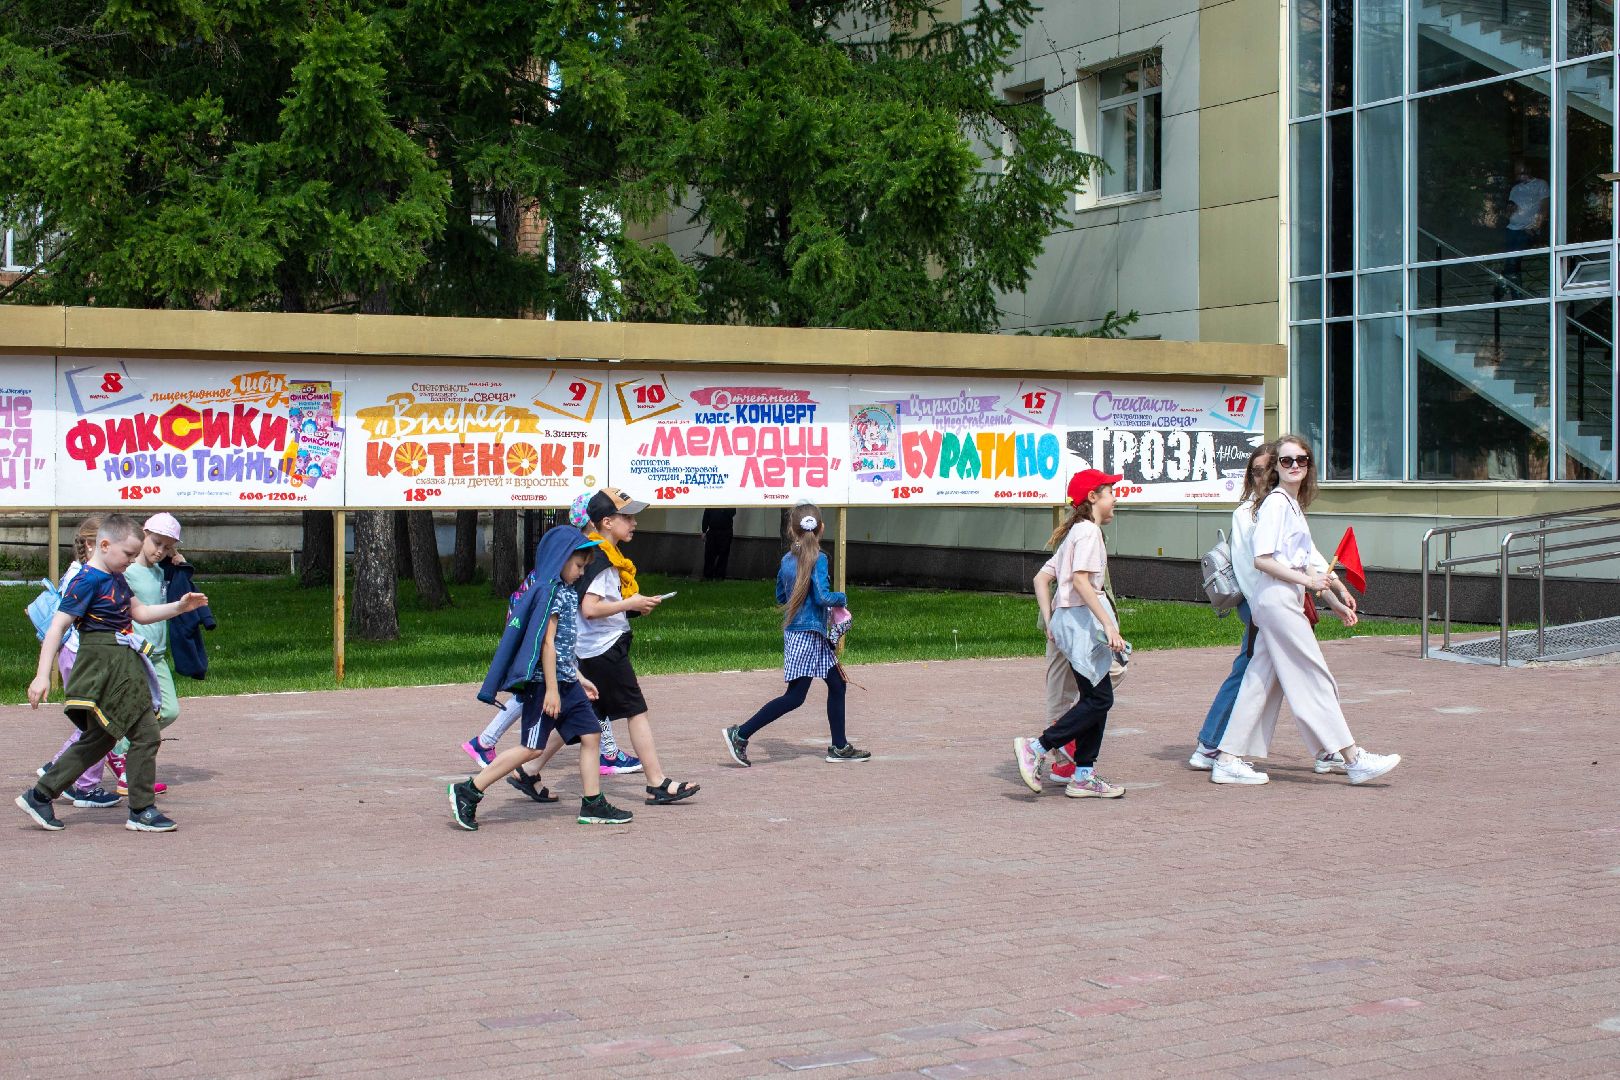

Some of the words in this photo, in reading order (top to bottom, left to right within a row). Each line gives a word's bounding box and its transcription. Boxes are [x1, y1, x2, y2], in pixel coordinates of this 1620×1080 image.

[101, 373, 124, 393] 8
[412, 383, 470, 393] Спектакль
[569, 382, 588, 402] 9
[150, 388, 232, 404] лицензионное
[633, 385, 665, 403] 10
[710, 389, 799, 411] Отчетный
[1022, 392, 1047, 409] 15
[1224, 395, 1248, 412] 17
[909, 393, 981, 421] Цирковое
[1092, 390, 1179, 421] Спектакль
[931, 412, 1013, 435] представление
[65, 403, 289, 471] ФИКСИКИ
[544, 429, 588, 439] В.Зинчук
[901, 430, 1060, 480] БУРАТИНО
[1092, 429, 1217, 481] ГРОЗА
[415, 478, 446, 486] сказка
[448, 477, 466, 487] для
[467, 475, 504, 489] детей
[514, 478, 569, 488] взрослых
